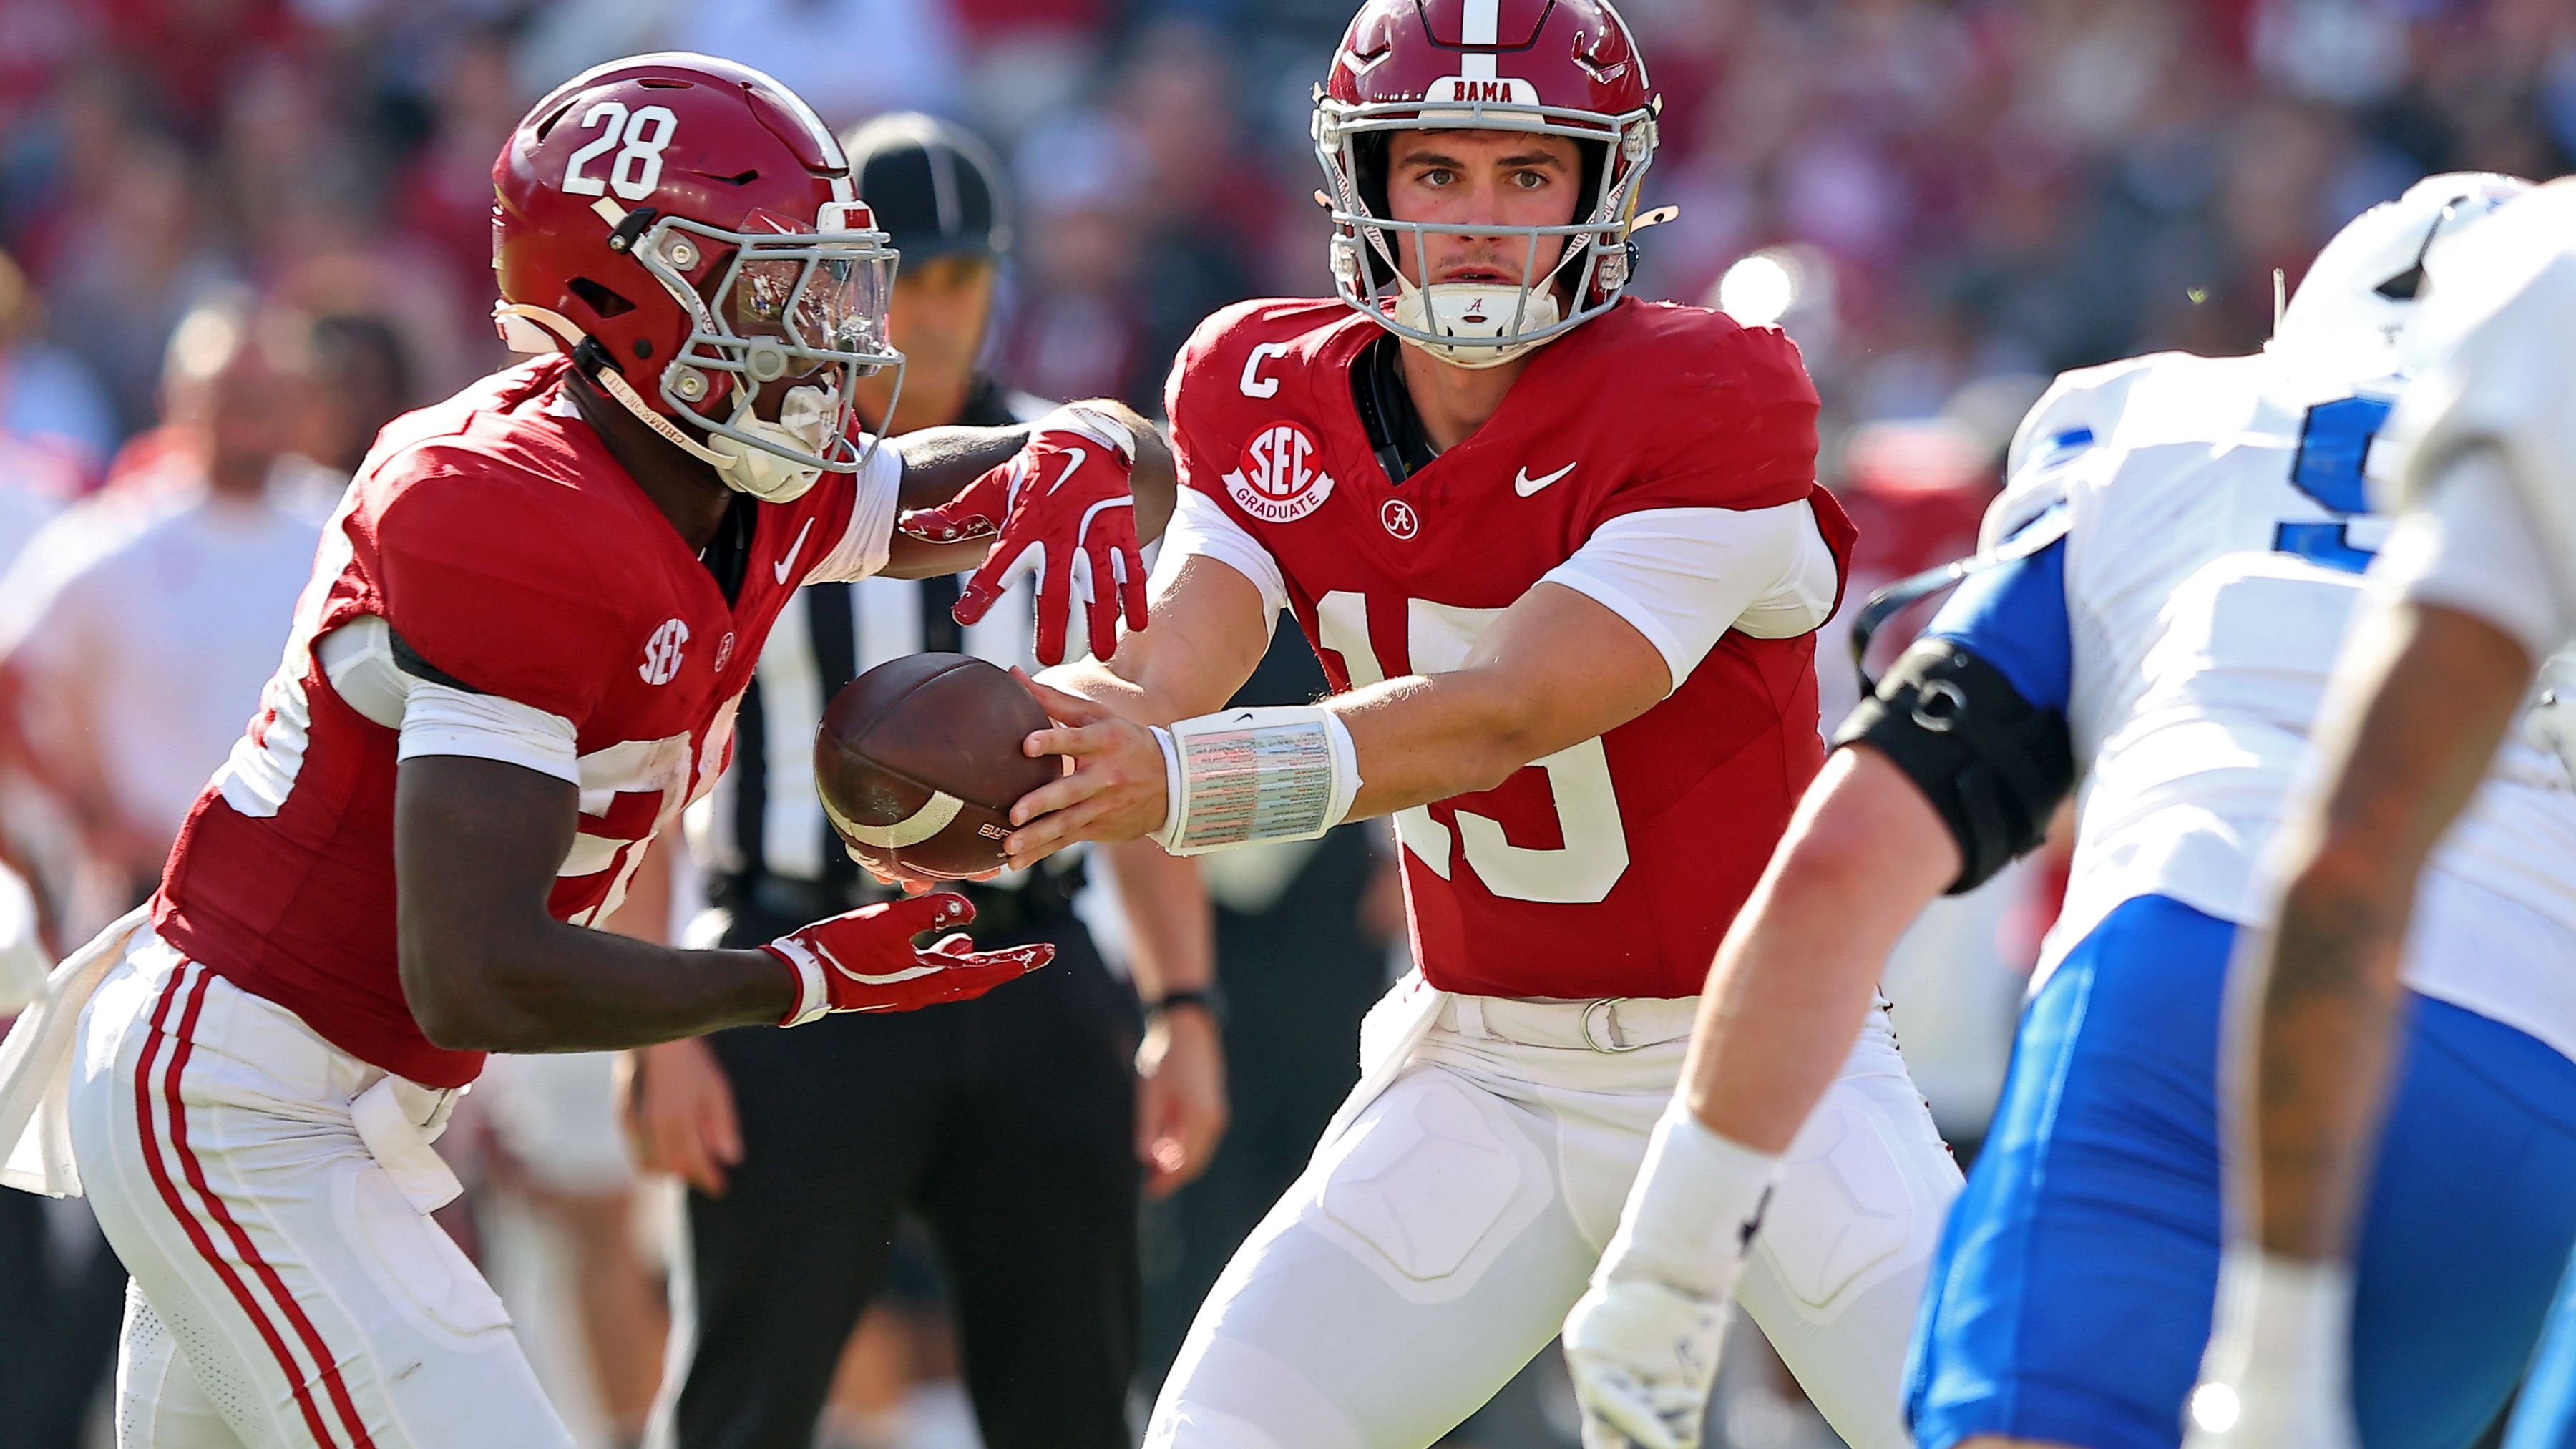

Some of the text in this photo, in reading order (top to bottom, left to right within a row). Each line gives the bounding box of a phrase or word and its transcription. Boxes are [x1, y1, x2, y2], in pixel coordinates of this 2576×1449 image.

[1454, 82, 1512, 102] BAMA
[562, 102, 679, 201] 28
[1239, 342, 1287, 399] C
[1249, 426, 1314, 495] SEC
[1236, 487, 1319, 519] GRADUATE
[1388, 505, 1411, 531] A
[638, 618, 690, 686] SEC
